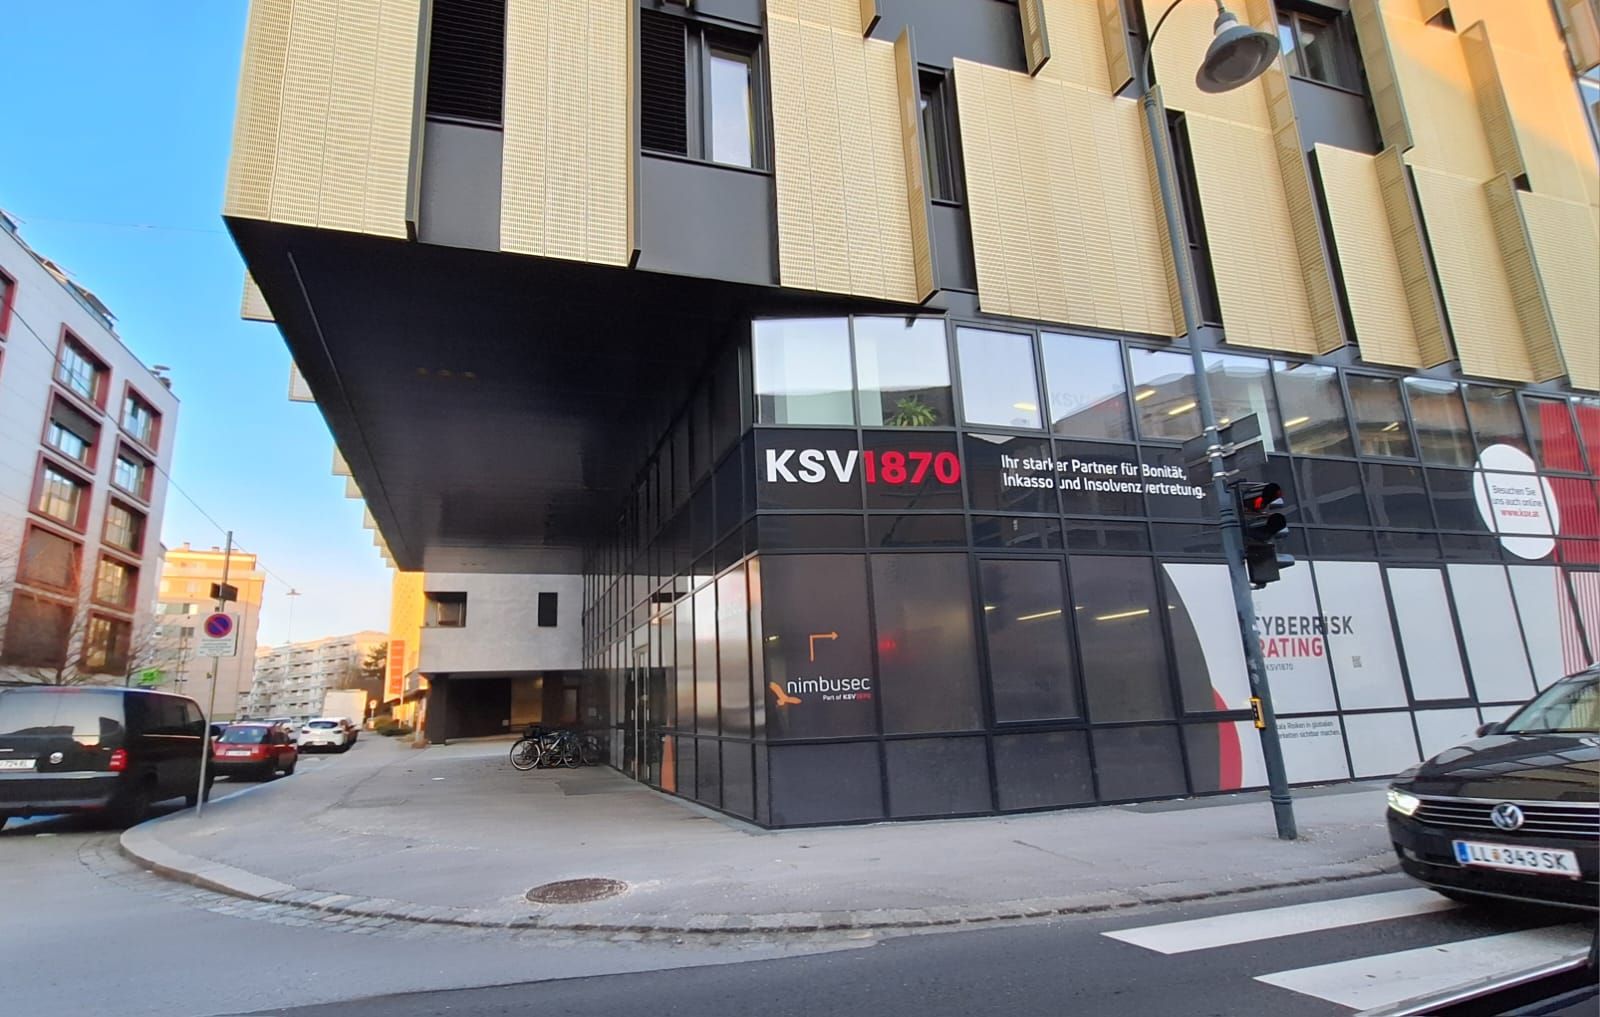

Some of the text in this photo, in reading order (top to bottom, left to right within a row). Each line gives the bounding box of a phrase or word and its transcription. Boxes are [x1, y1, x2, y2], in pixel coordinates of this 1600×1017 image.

[765, 448, 962, 484] KSV1870
[1001, 454, 1187, 481] Ihr starker Partner für Bonität,
[1003, 473, 1054, 489] Inkasso
[1059, 476, 1081, 490] und
[1255, 615, 1354, 636] YBERRISK
[786, 675, 871, 694] nimbusec
[822, 694, 835, 702] Part
[1470, 845, 1569, 871] LL 343 SK
